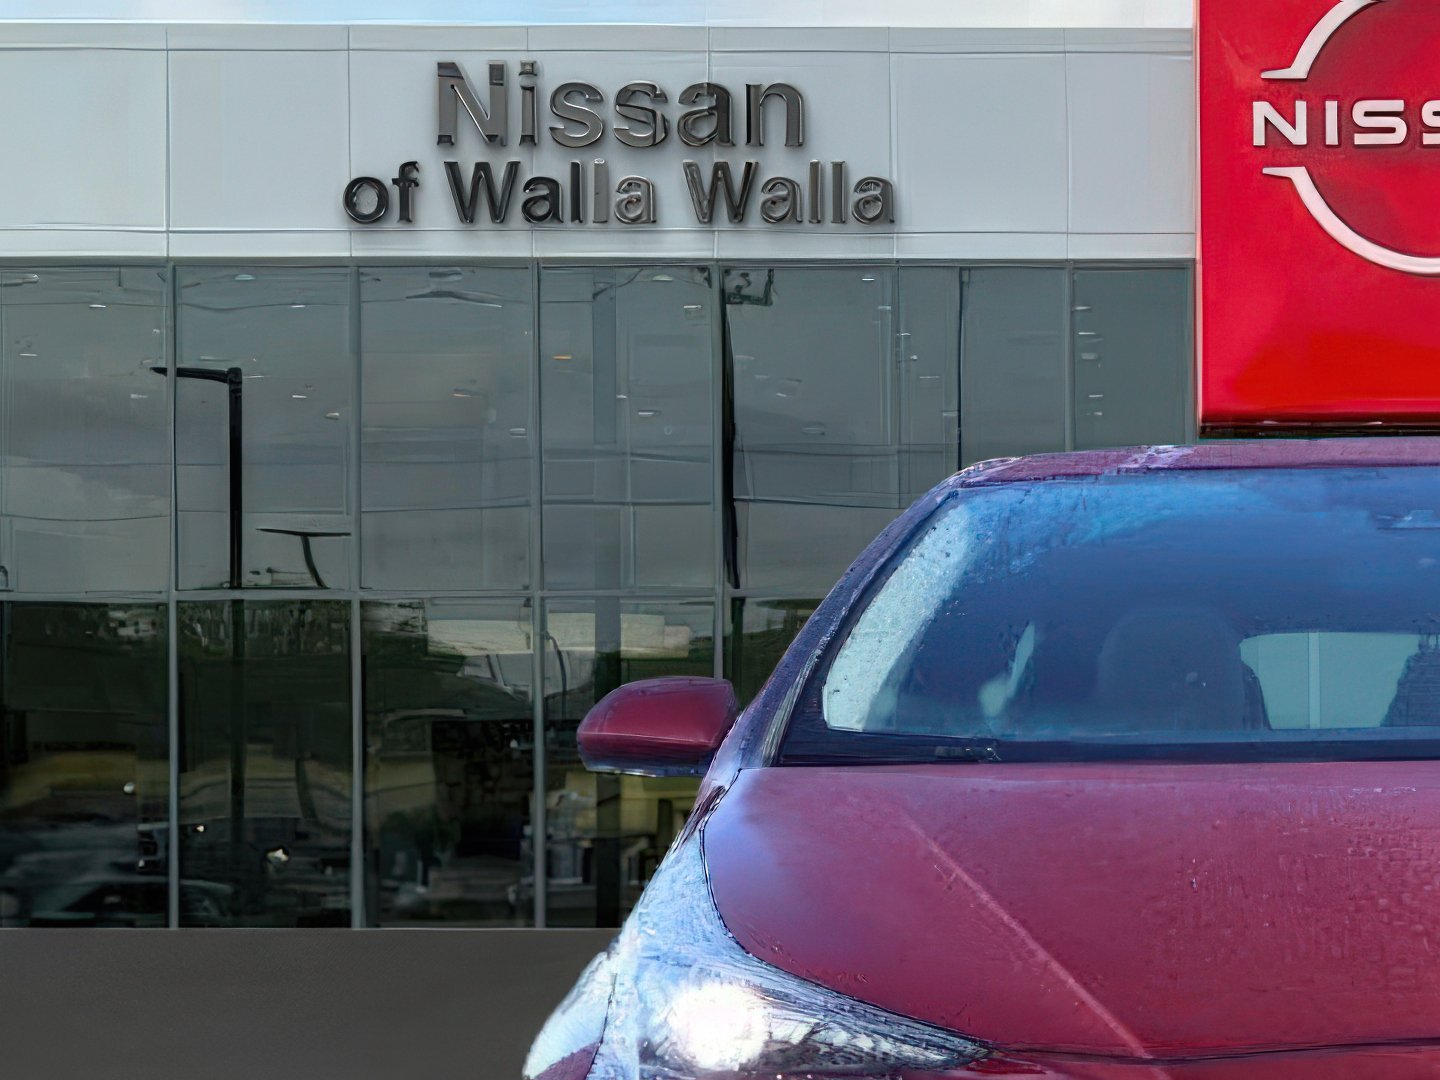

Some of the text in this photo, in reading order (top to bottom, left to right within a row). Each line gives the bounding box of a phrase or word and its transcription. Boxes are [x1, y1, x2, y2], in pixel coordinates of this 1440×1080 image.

[436, 60, 805, 148] Nissan
[342, 159, 897, 226] of Walla Walla
